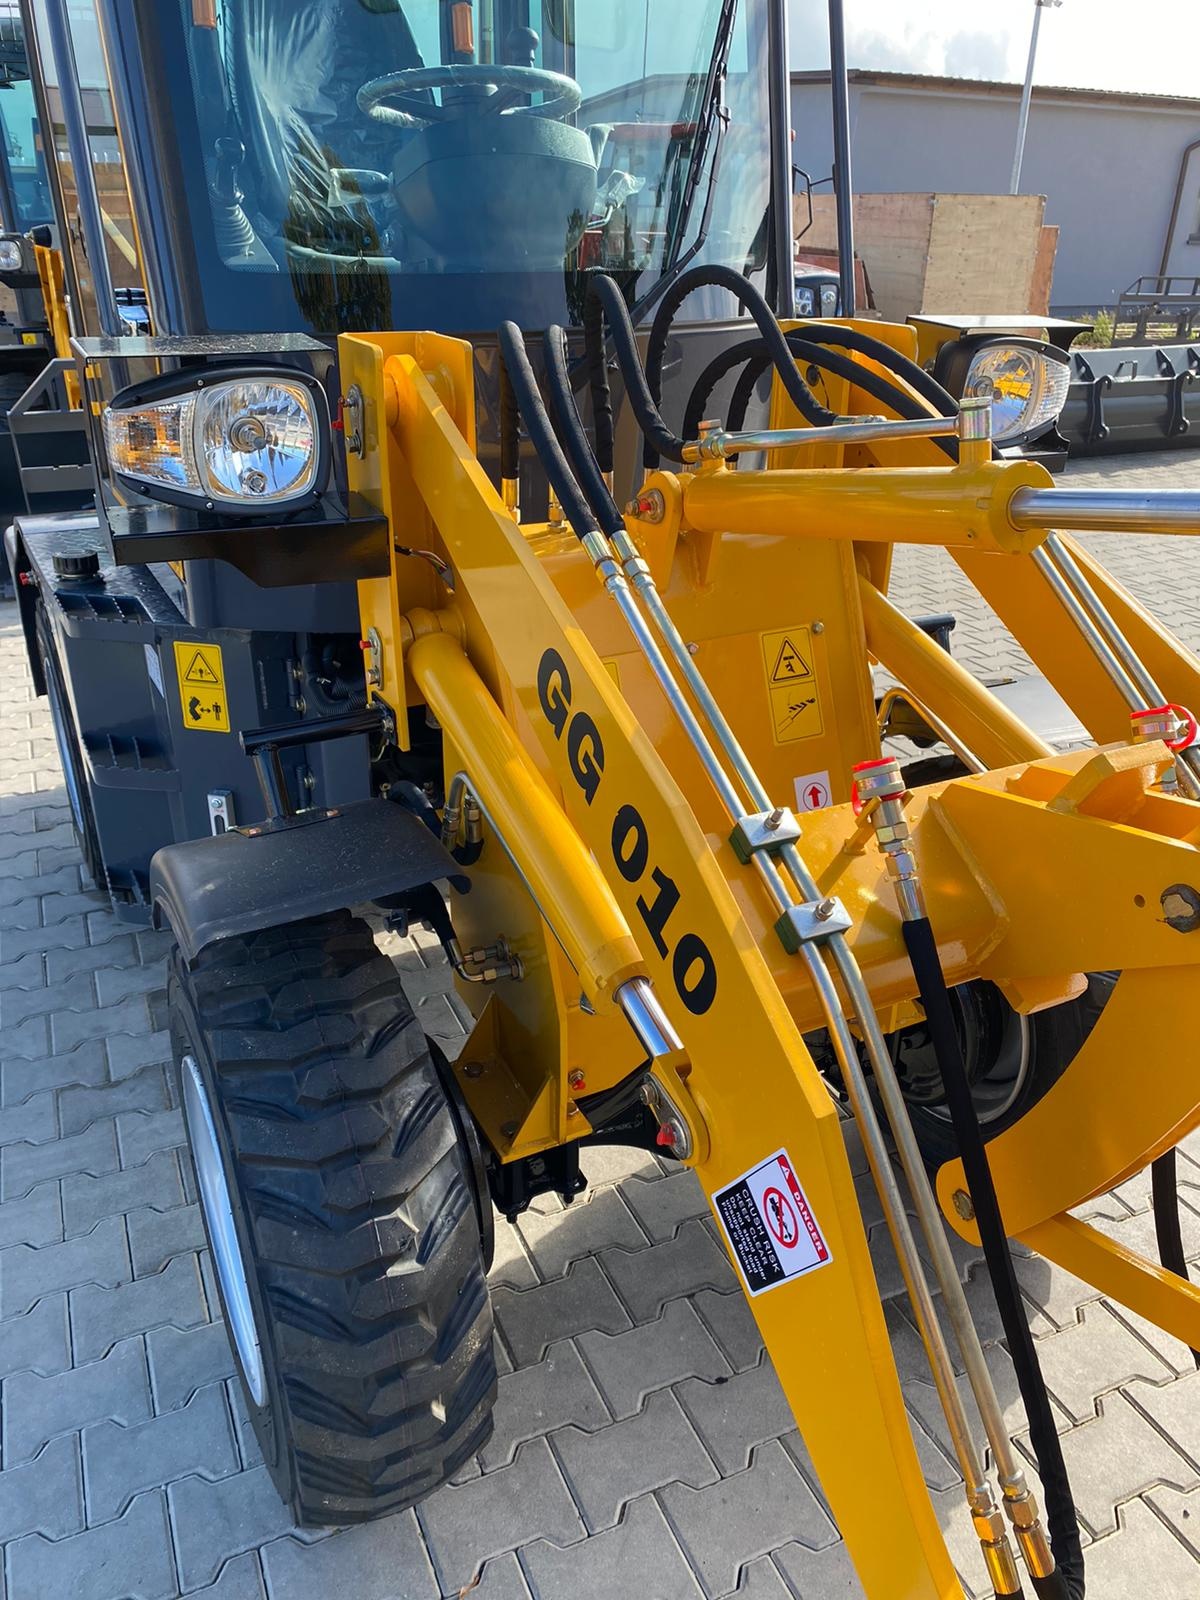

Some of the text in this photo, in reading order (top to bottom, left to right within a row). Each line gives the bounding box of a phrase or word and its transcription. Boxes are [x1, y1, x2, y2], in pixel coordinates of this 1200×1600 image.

[537, 647, 717, 1016] GG 010
[726, 1199, 758, 1274] unsupported load
[729, 1196, 767, 1280] Do not stand under
[733, 1231, 740, 1241] or
[738, 1244, 752, 1274] Bucket
[735, 1192, 768, 1265] KEEP CLEAR
[742, 1189, 780, 1273] CRUSH RISK
[794, 1192, 822, 1251] DANGER
